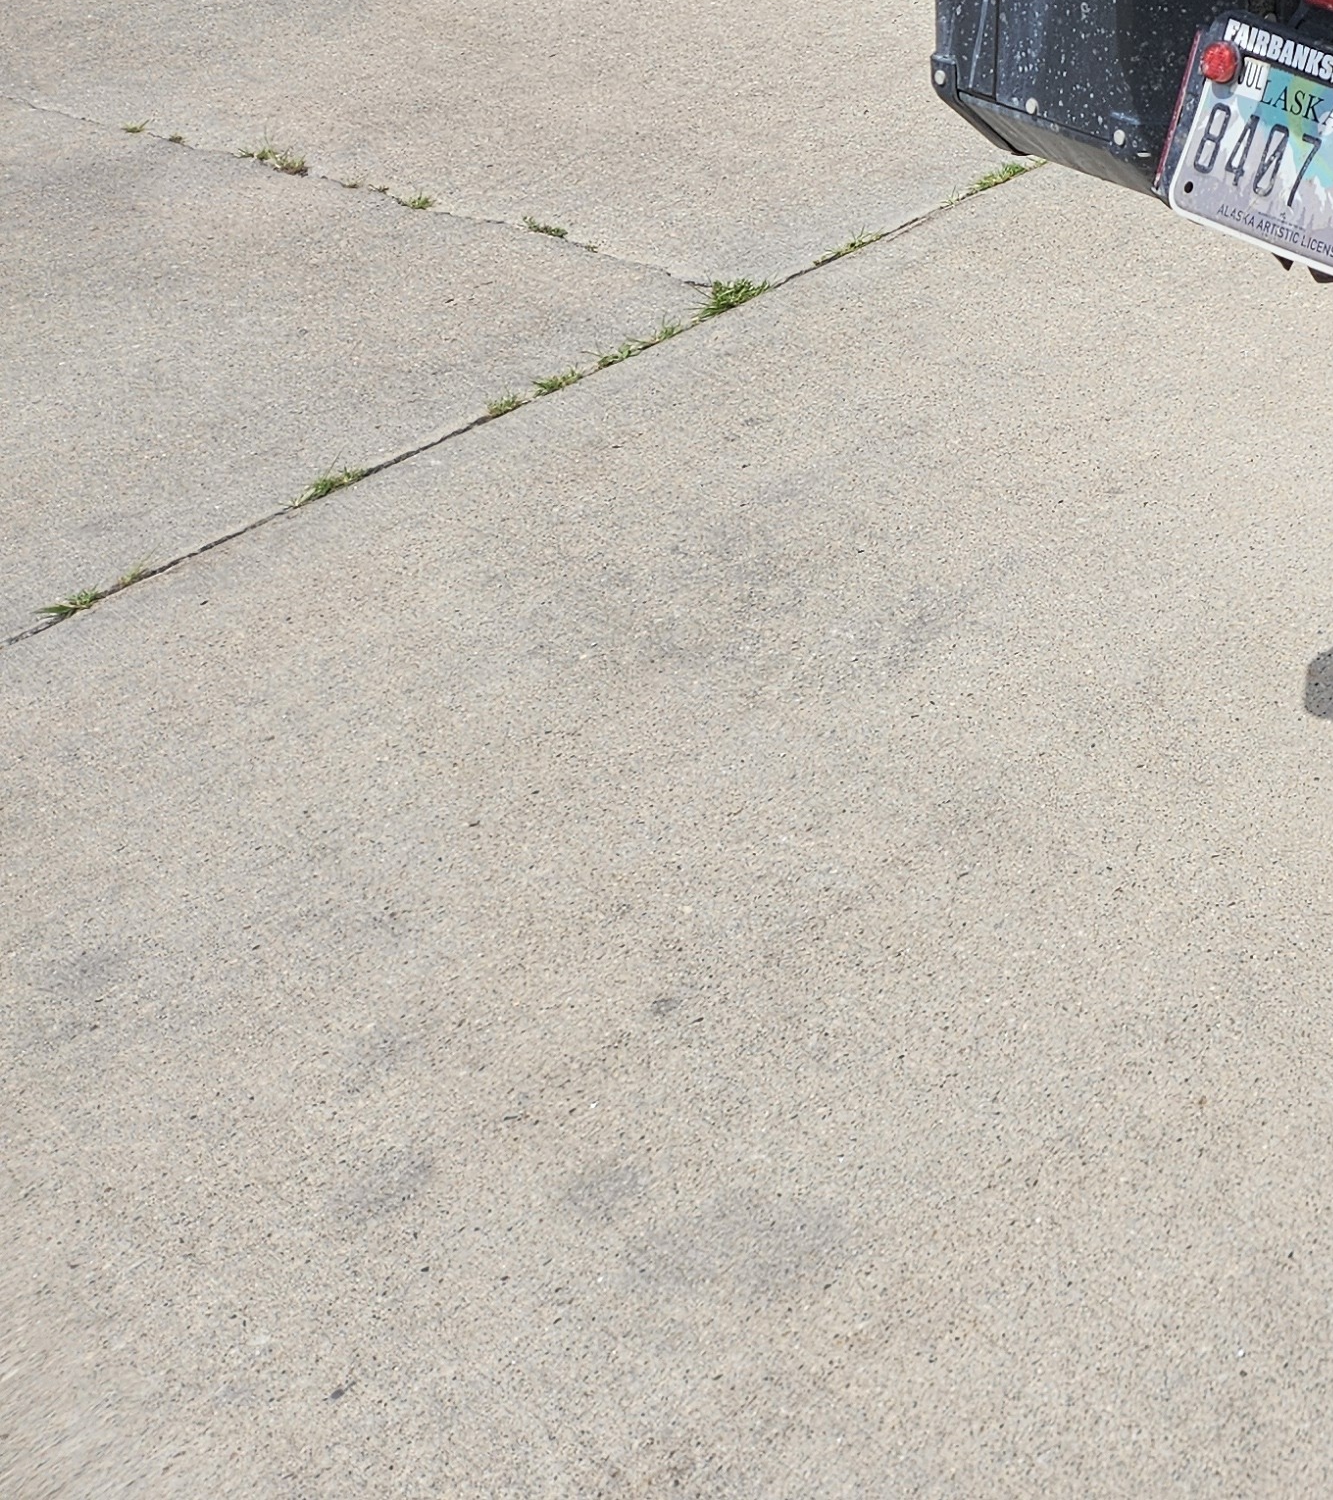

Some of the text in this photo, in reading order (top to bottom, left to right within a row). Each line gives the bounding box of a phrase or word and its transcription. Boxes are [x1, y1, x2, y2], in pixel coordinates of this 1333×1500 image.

[1237, 58, 1264, 91] JUL
[1193, 102, 1323, 208] 8407
[1218, 204, 1255, 227] ALASKA
[1256, 219, 1300, 245] ARTISTIC
